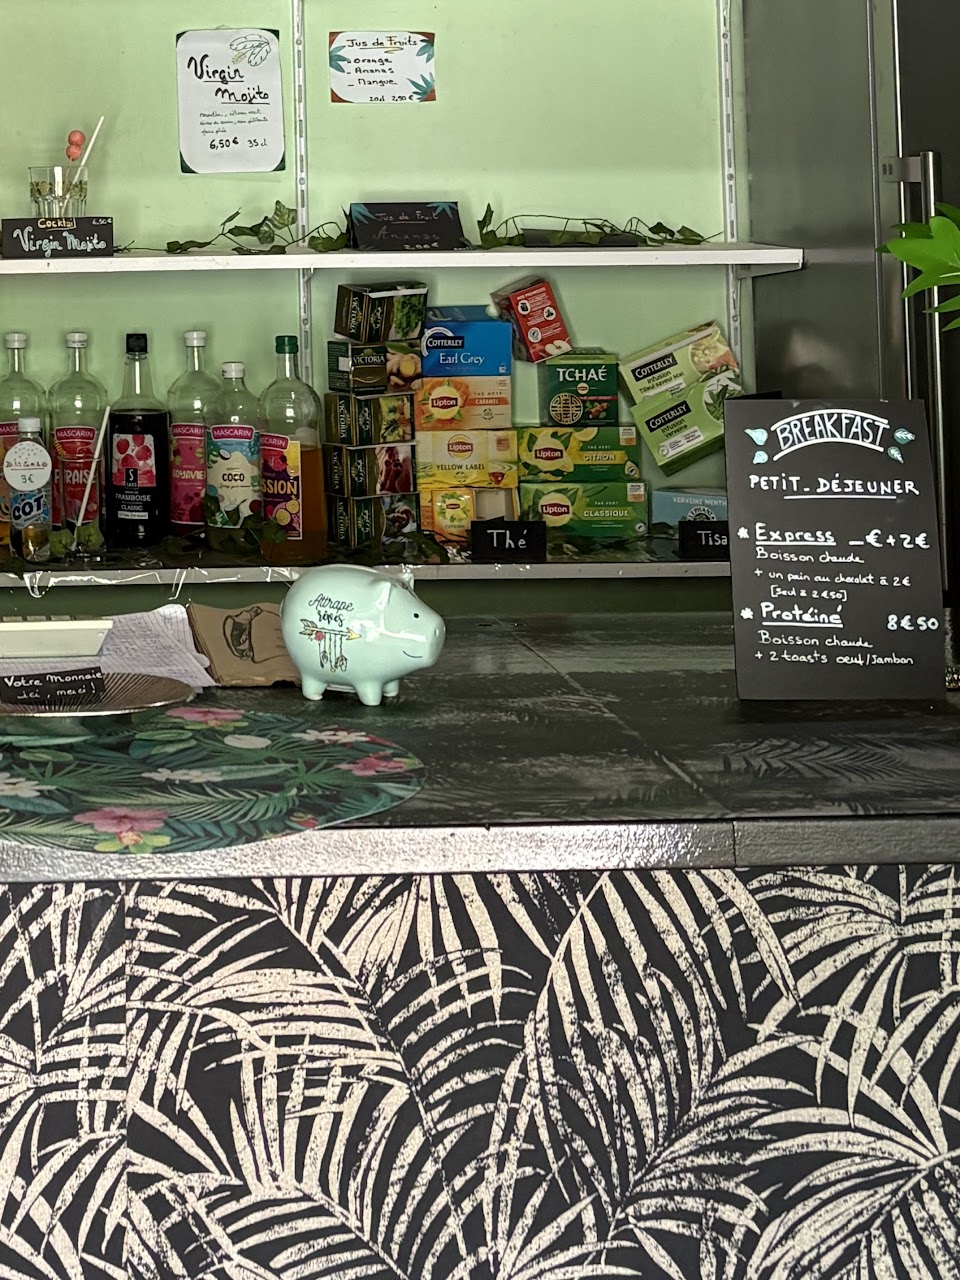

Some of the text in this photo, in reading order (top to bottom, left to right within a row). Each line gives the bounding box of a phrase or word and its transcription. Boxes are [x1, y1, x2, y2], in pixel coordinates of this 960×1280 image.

[346, 35, 418, 48] Jus de Fruits
[187, 53, 245, 85] Virgin
[354, 66, 395, 74] Ananas
[12, 225, 64, 258] Virgin
[352, 355, 386, 365] VICTORIA
[439, 352, 486, 366] Earl Grey
[555, 365, 608, 382] TCHAÉ
[433, 398, 457, 408] Lipton
[0, 424, 19, 434] MASC
[56, 429, 94, 439] MASCARIN
[213, 427, 252, 438] MASCARIN
[776, 412, 890, 451] BREAKFAST
[259, 436, 287, 448] SCARIN
[448, 443, 472, 453] Lipton
[536, 449, 562, 459] Lipton
[436, 463, 463, 471] YELLOW
[222, 472, 245, 483] COCO
[260, 479, 298, 495] SSION
[12, 494, 45, 522] COT
[542, 505, 569, 515] Lipton
[583, 509, 629, 518] CLASSIQUE
[486, 529, 528, 549] Thé
[696, 530, 728, 546] Tisa
[755, 522, 836, 544] Express
[755, 546, 865, 564] Boisson chaude
[768, 572, 784, 581] un
[787, 572, 811, 583] pain
[813, 575, 831, 583] au
[834, 573, 875, 585] chocolat
[308, 593, 355, 614] Attrape
[760, 601, 843, 625] Protéiné
[757, 630, 874, 649] Boisson chaude
[769, 651, 779, 662] 2
[780, 649, 828, 664] toasts
[3, 669, 103, 688] Votre Monnaie
